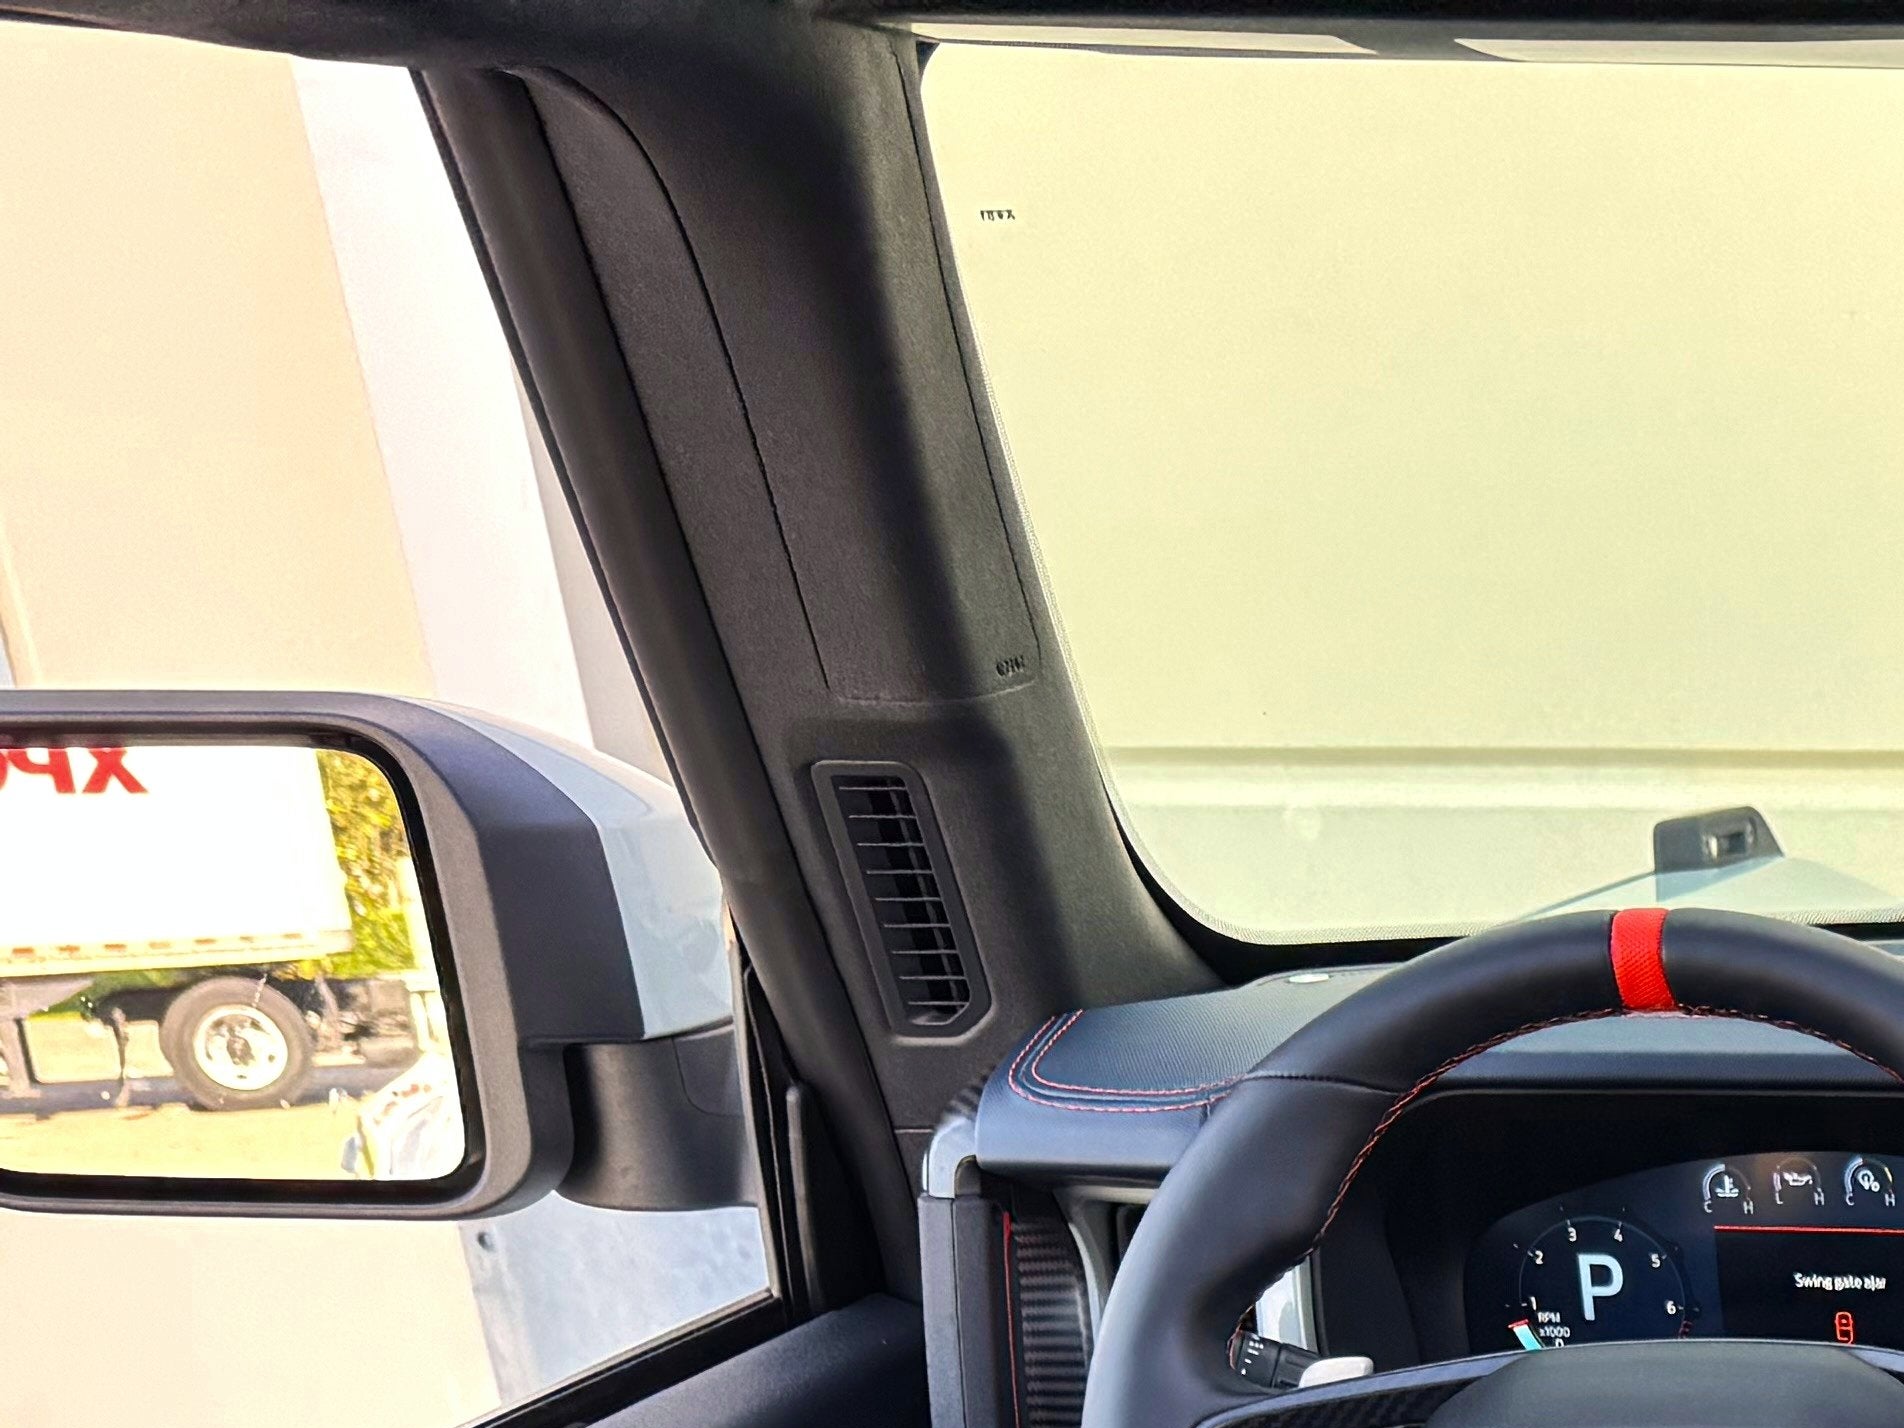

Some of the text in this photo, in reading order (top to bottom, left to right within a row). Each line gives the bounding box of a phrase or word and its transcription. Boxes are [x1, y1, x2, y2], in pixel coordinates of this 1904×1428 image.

[1813, 1191, 1825, 1206] H
[1884, 1193, 1896, 1207] H
[1743, 1201, 1754, 1214] H
[1567, 1227, 1577, 1242] 3
[1613, 1228, 1624, 1243] 4
[1534, 1250, 1544, 1265] 2
[1651, 1253, 1661, 1268] 5
[1578, 1254, 1624, 1321] P
[1793, 1271, 1833, 1290] Swing
[1530, 1296, 1537, 1310] 1
[1666, 1301, 1677, 1315] 6
